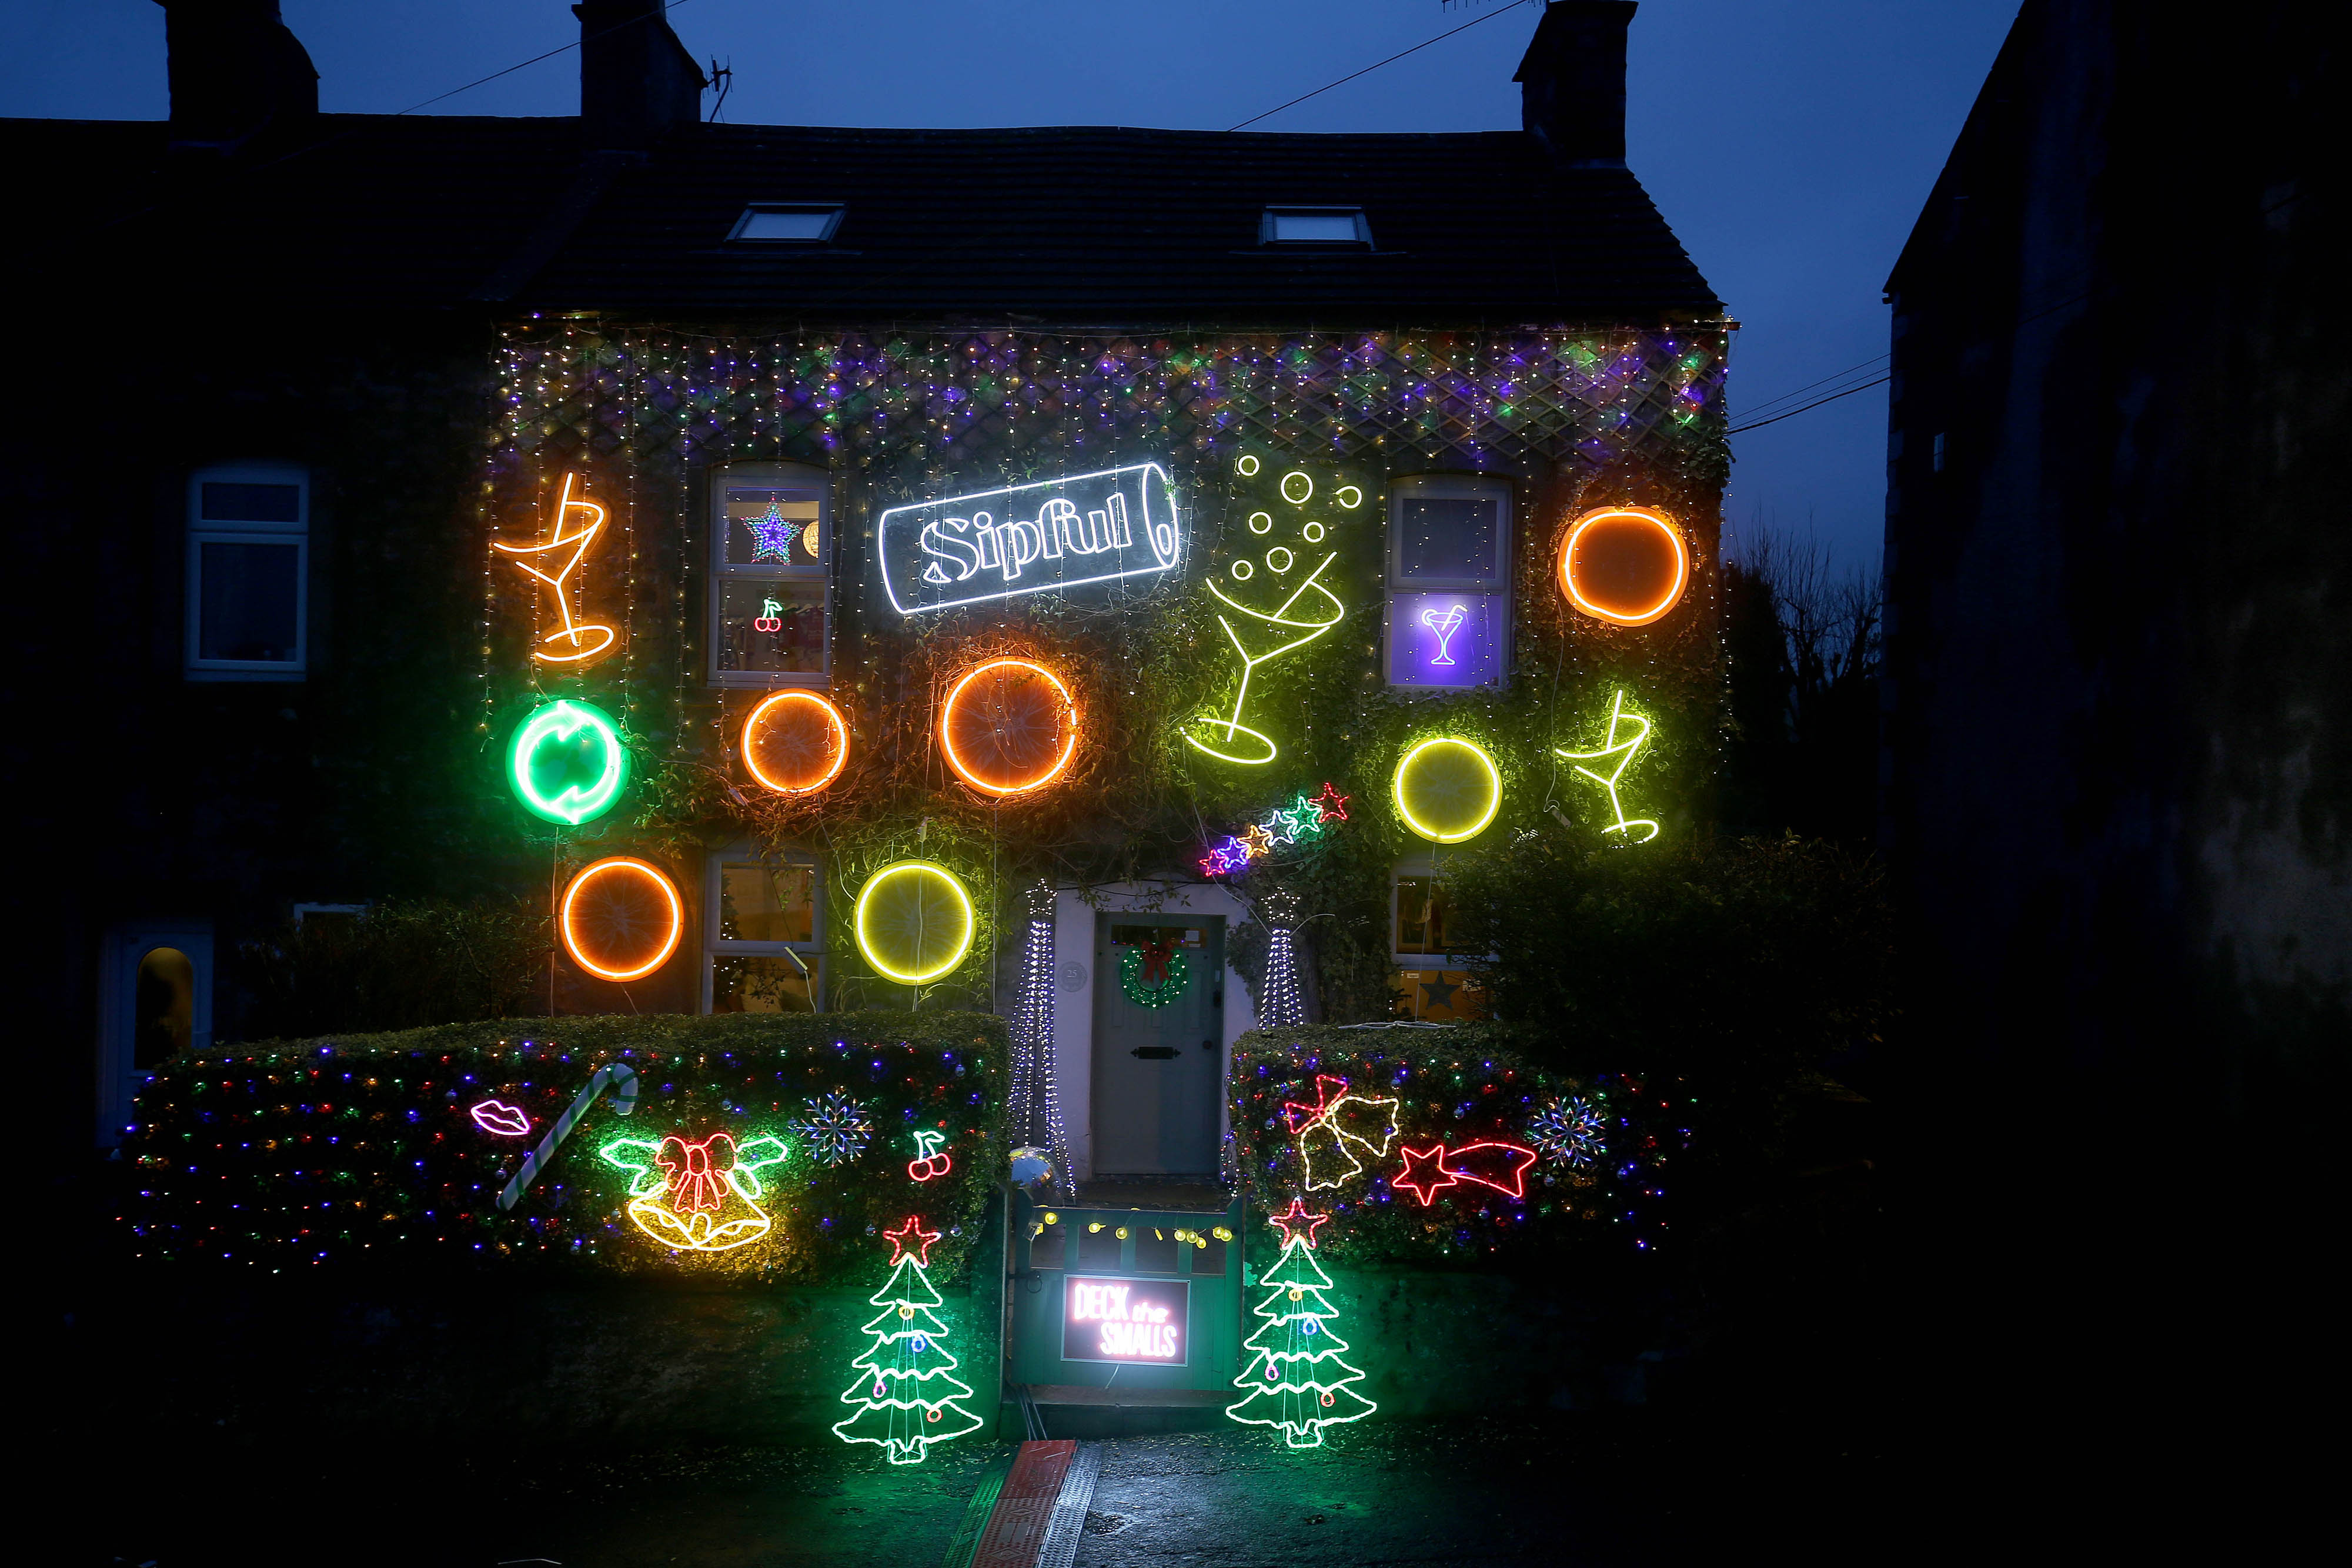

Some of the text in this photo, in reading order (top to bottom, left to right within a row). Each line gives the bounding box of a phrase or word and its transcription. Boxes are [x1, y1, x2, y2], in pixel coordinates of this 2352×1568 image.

[920, 492, 1132, 583] Sipful
[1074, 1283, 1169, 1323] DECK the
[1100, 1322, 1177, 1358] SMALLS
